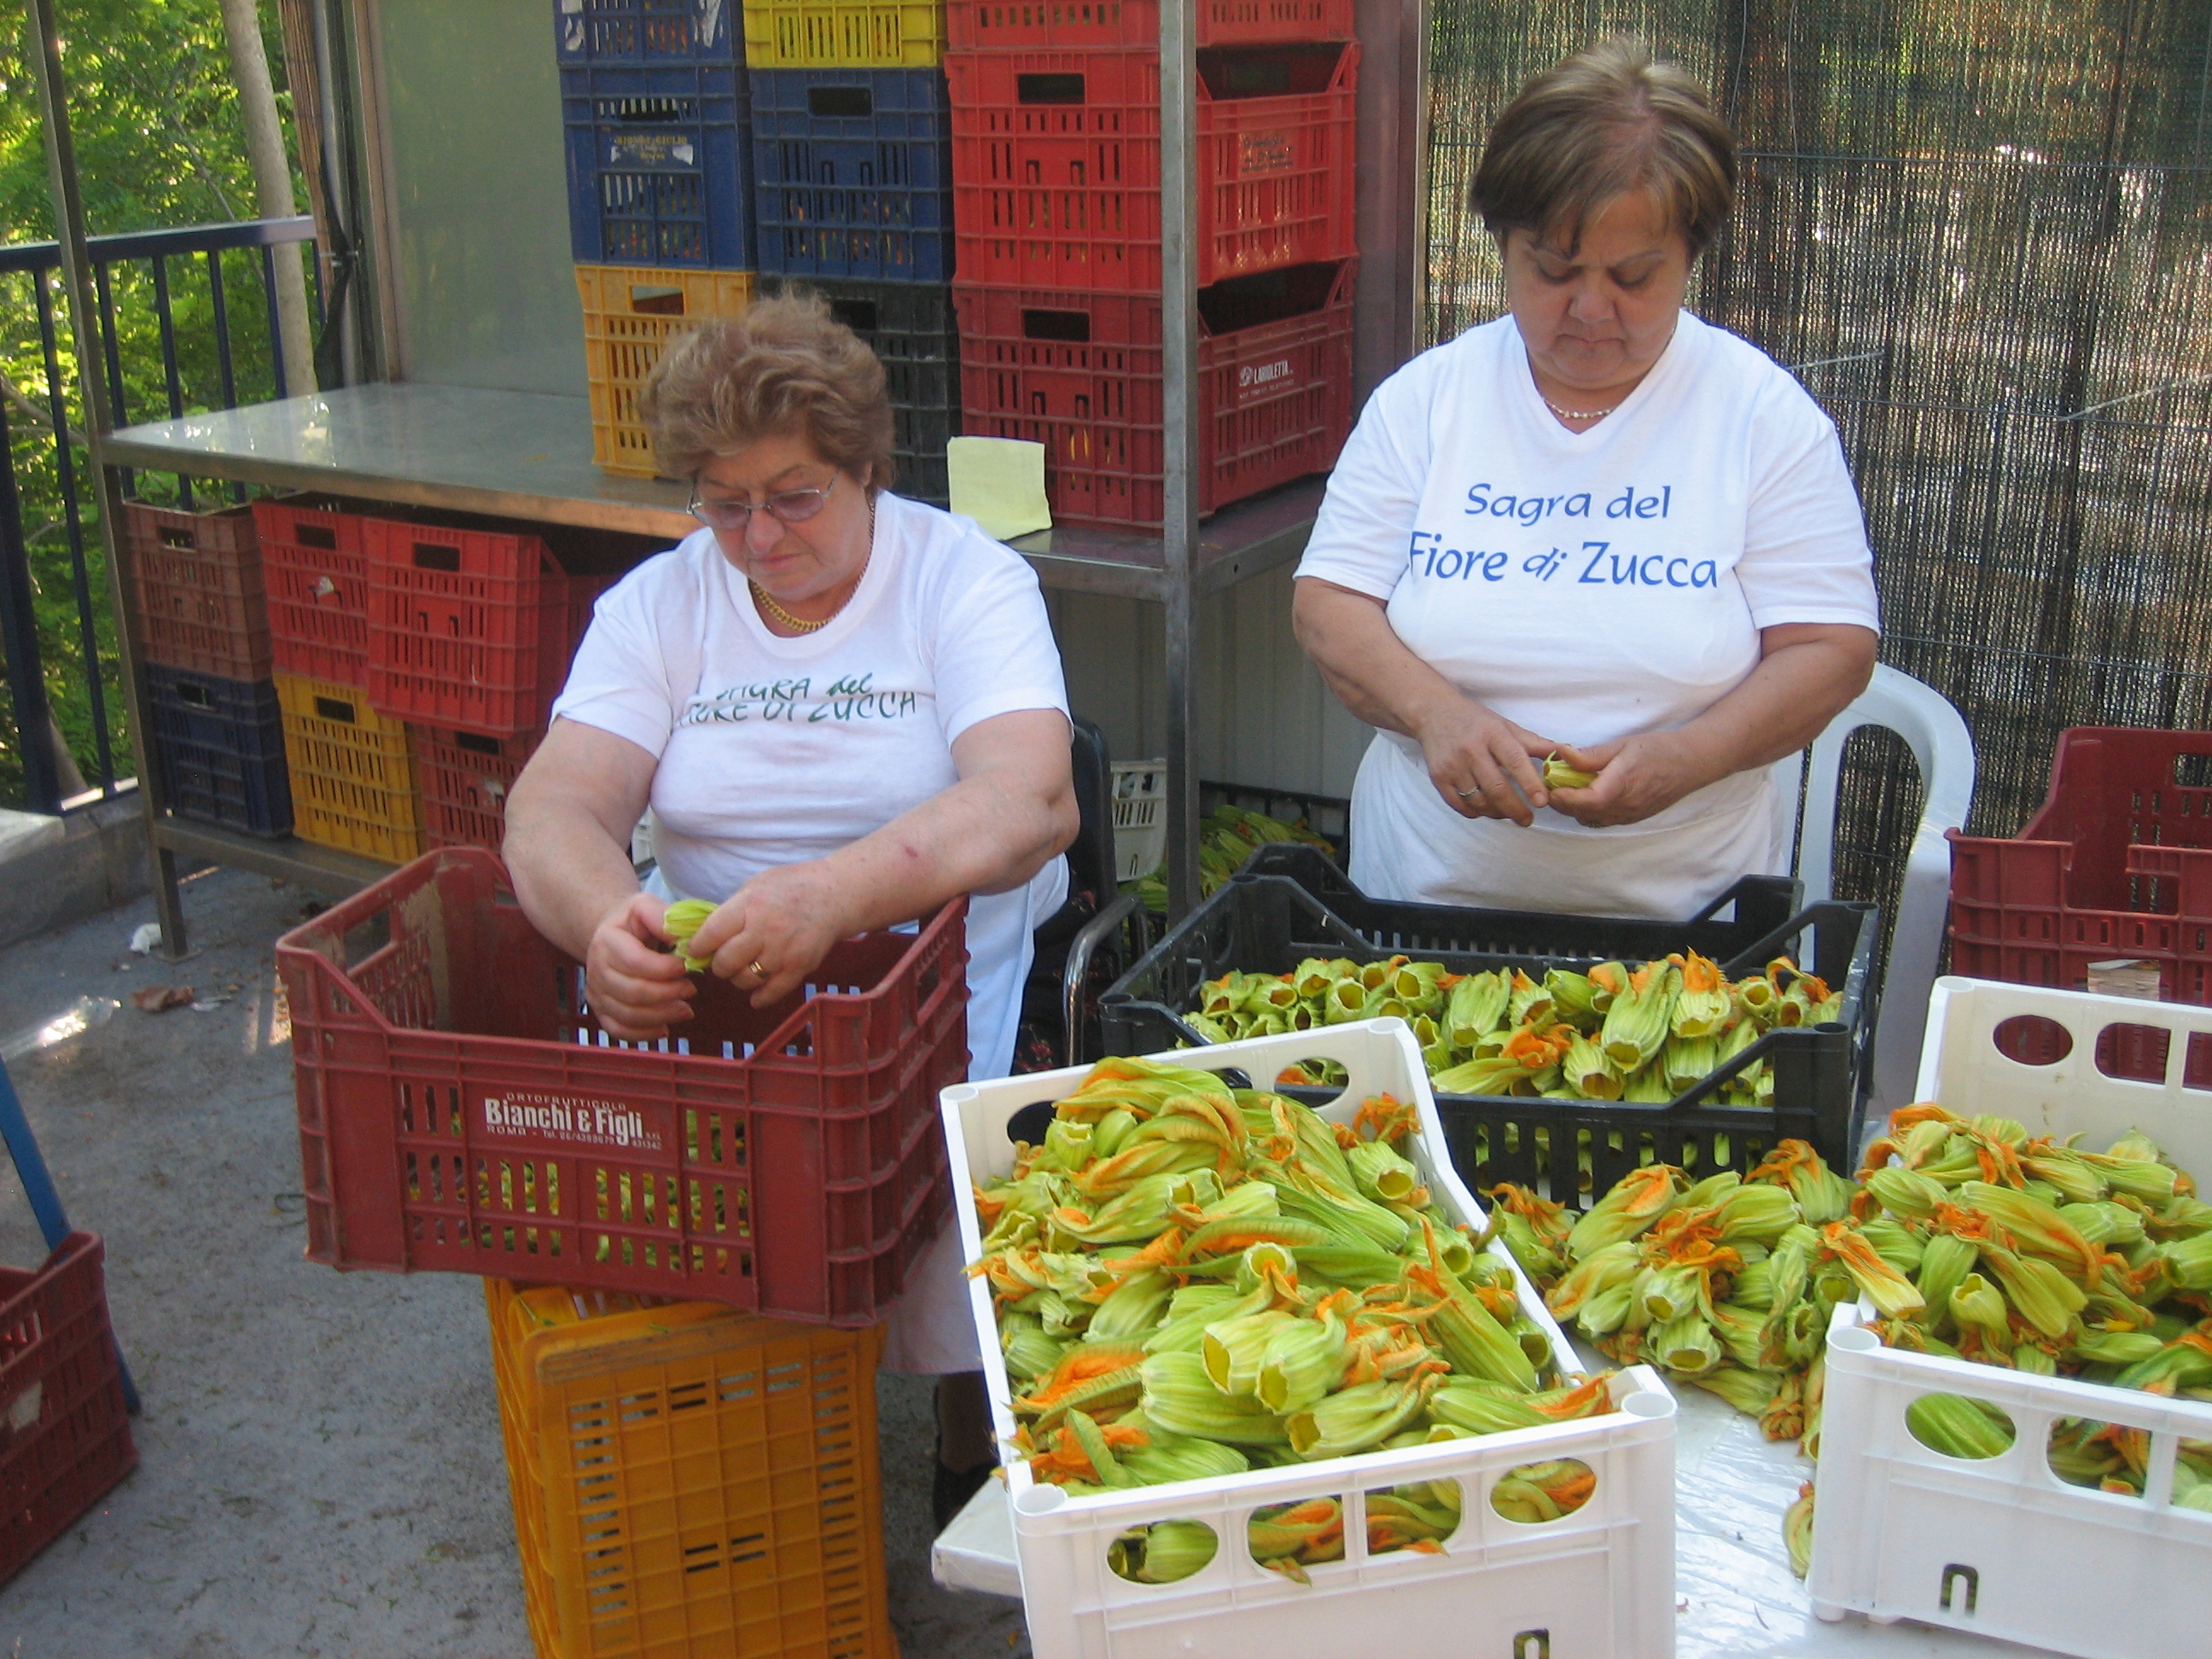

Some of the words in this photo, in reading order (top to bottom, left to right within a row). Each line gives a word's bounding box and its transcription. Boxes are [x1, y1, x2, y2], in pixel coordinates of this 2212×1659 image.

[1464, 482, 1592, 527] Sagra
[1606, 486, 1672, 519] del
[1409, 531, 1509, 582] Fiore
[1522, 547, 1568, 582] di
[1578, 541, 1718, 589] Zucca
[485, 1097, 573, 1132] Bianchi
[577, 1109, 592, 1133] &
[595, 1108, 643, 1146] Figli
[486, 1125, 527, 1137] ROMA
[543, 1129, 557, 1139] Tel.
